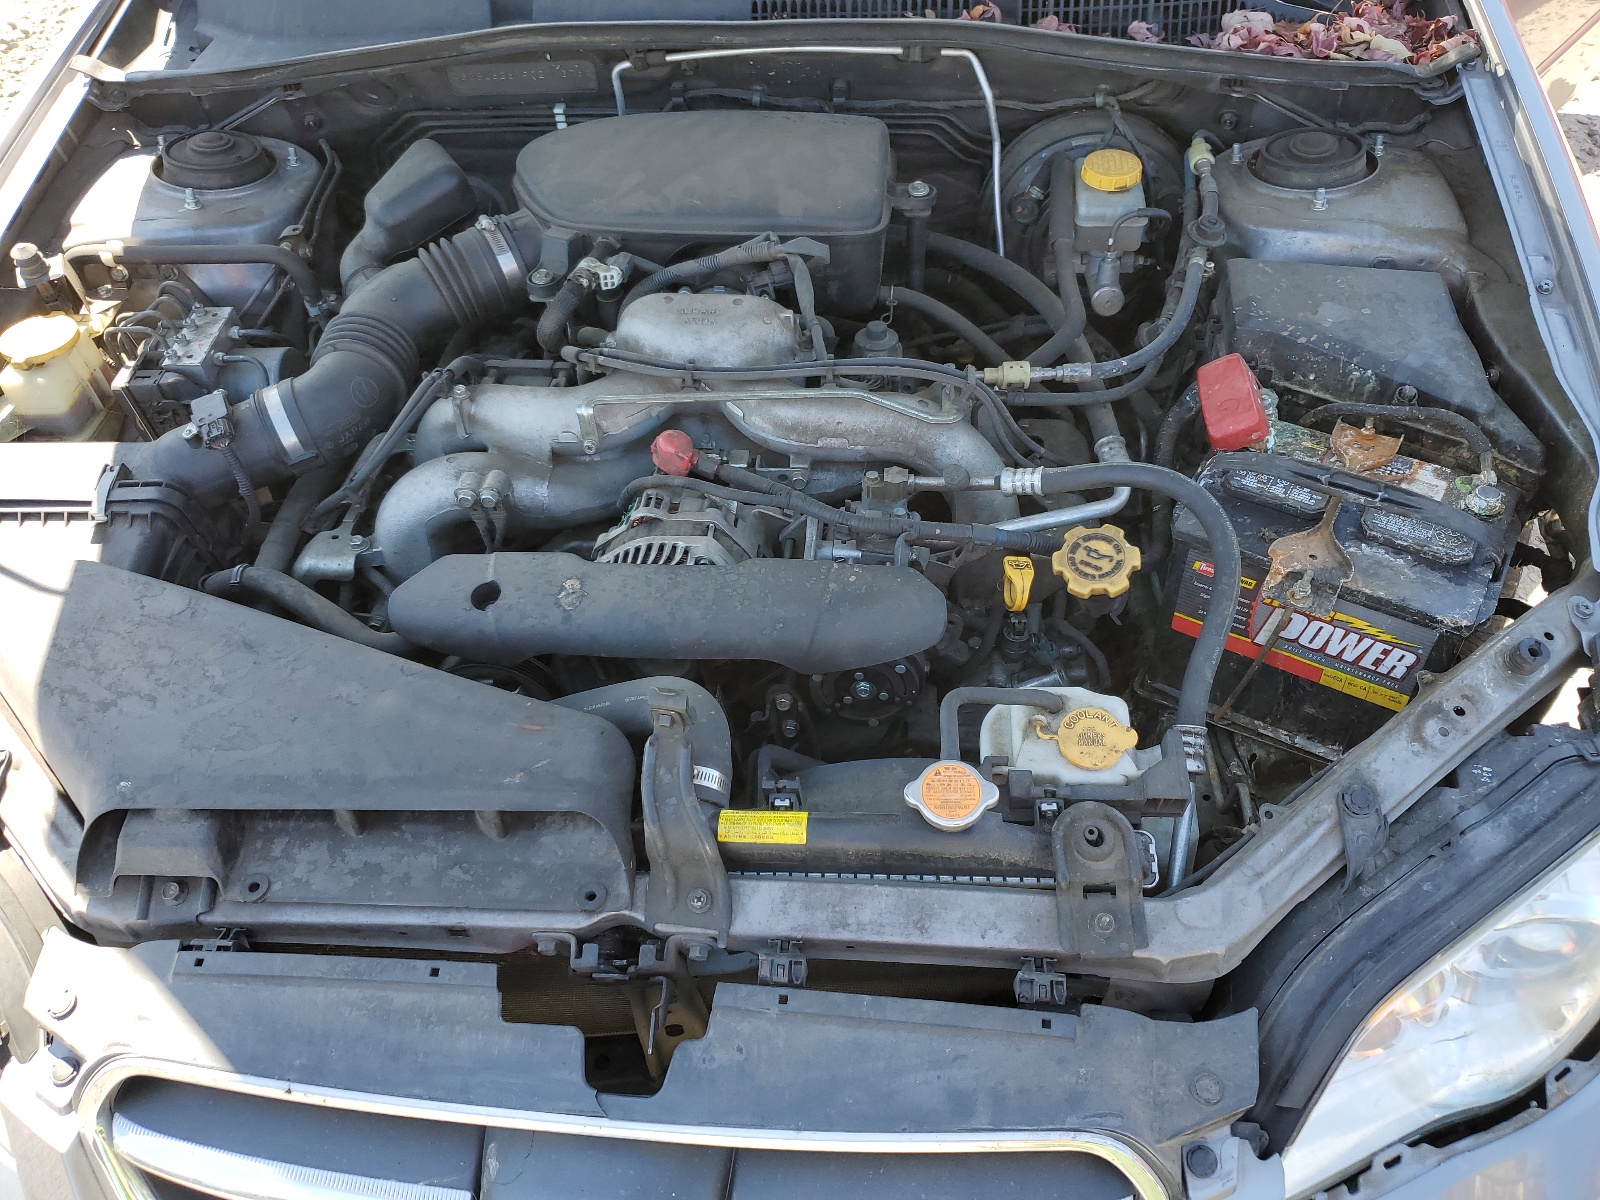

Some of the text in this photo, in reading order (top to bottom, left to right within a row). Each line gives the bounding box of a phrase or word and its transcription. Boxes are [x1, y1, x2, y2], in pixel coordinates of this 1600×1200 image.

[1112, 543, 1122, 555] OIL
[1253, 607, 1417, 680] POWER
[1063, 710, 1118, 729] COOLANT
[1077, 739, 1107, 747] MANUAL
